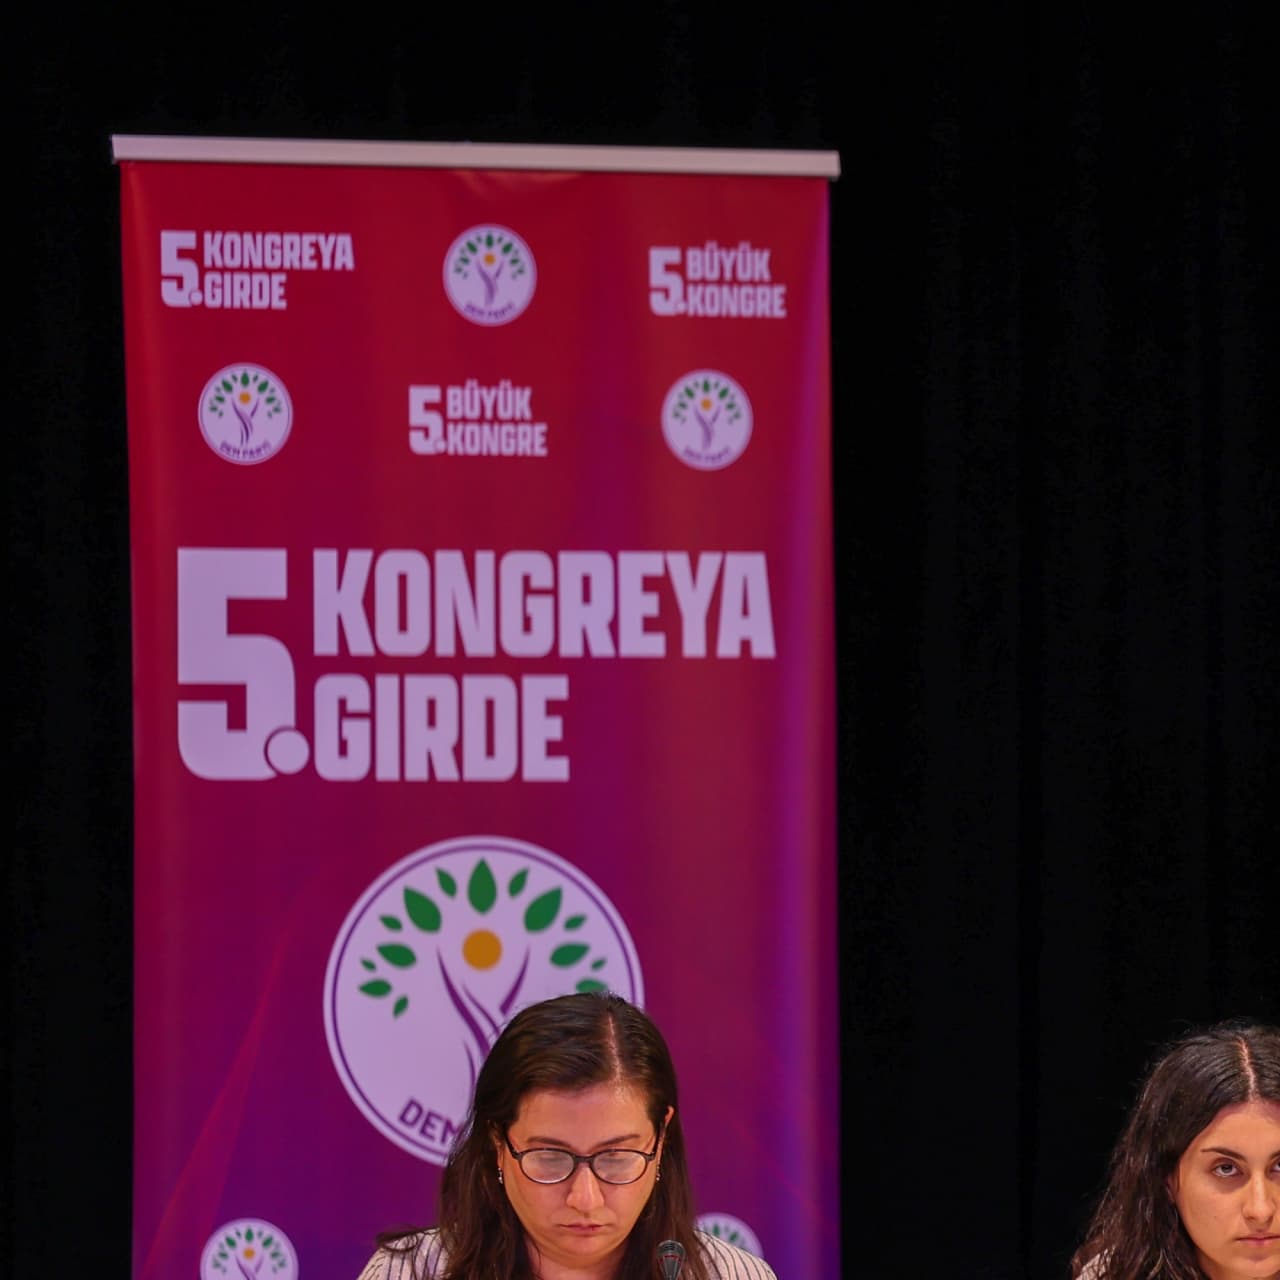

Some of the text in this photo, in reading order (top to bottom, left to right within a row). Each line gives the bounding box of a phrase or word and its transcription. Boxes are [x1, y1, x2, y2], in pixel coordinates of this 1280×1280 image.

[161, 231, 354, 308] 5. KONGREYA
[204, 272, 287, 309] GIRDE
[650, 243, 770, 315] 5. BÜYÜK
[687, 284, 786, 317] KONGRE
[409, 380, 532, 455] 5. BÜYÜK
[447, 422, 547, 457] KONGRE
[178, 548, 776, 780] 5. KONGREYA
[314, 674, 569, 781] GIRDE
